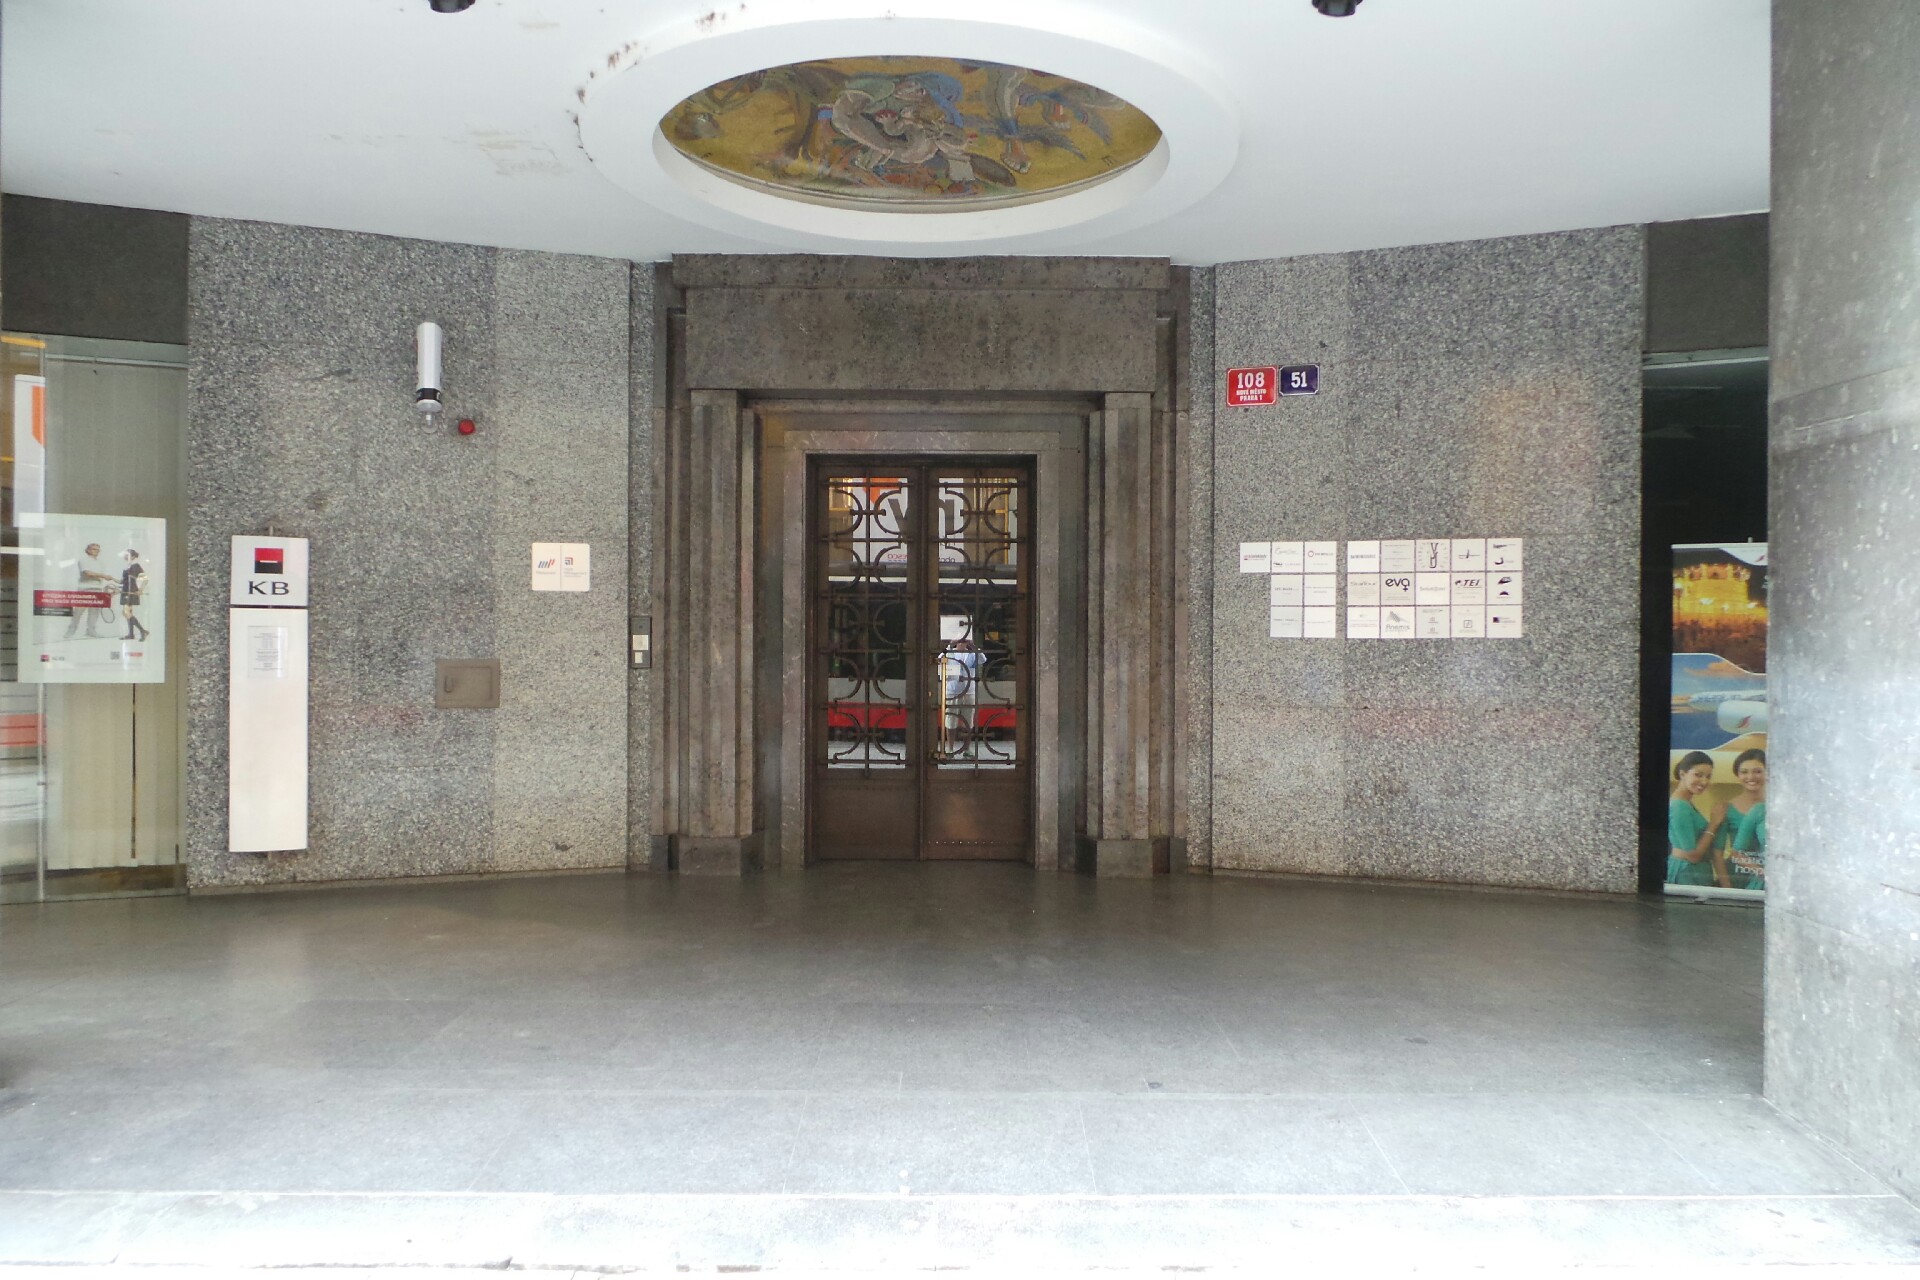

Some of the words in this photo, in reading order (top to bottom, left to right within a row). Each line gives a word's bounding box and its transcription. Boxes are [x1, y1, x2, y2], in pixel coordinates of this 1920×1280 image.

[1237, 372, 1265, 388] 108
[1291, 371, 1308, 388] 51
[248, 581, 290, 595] KB
